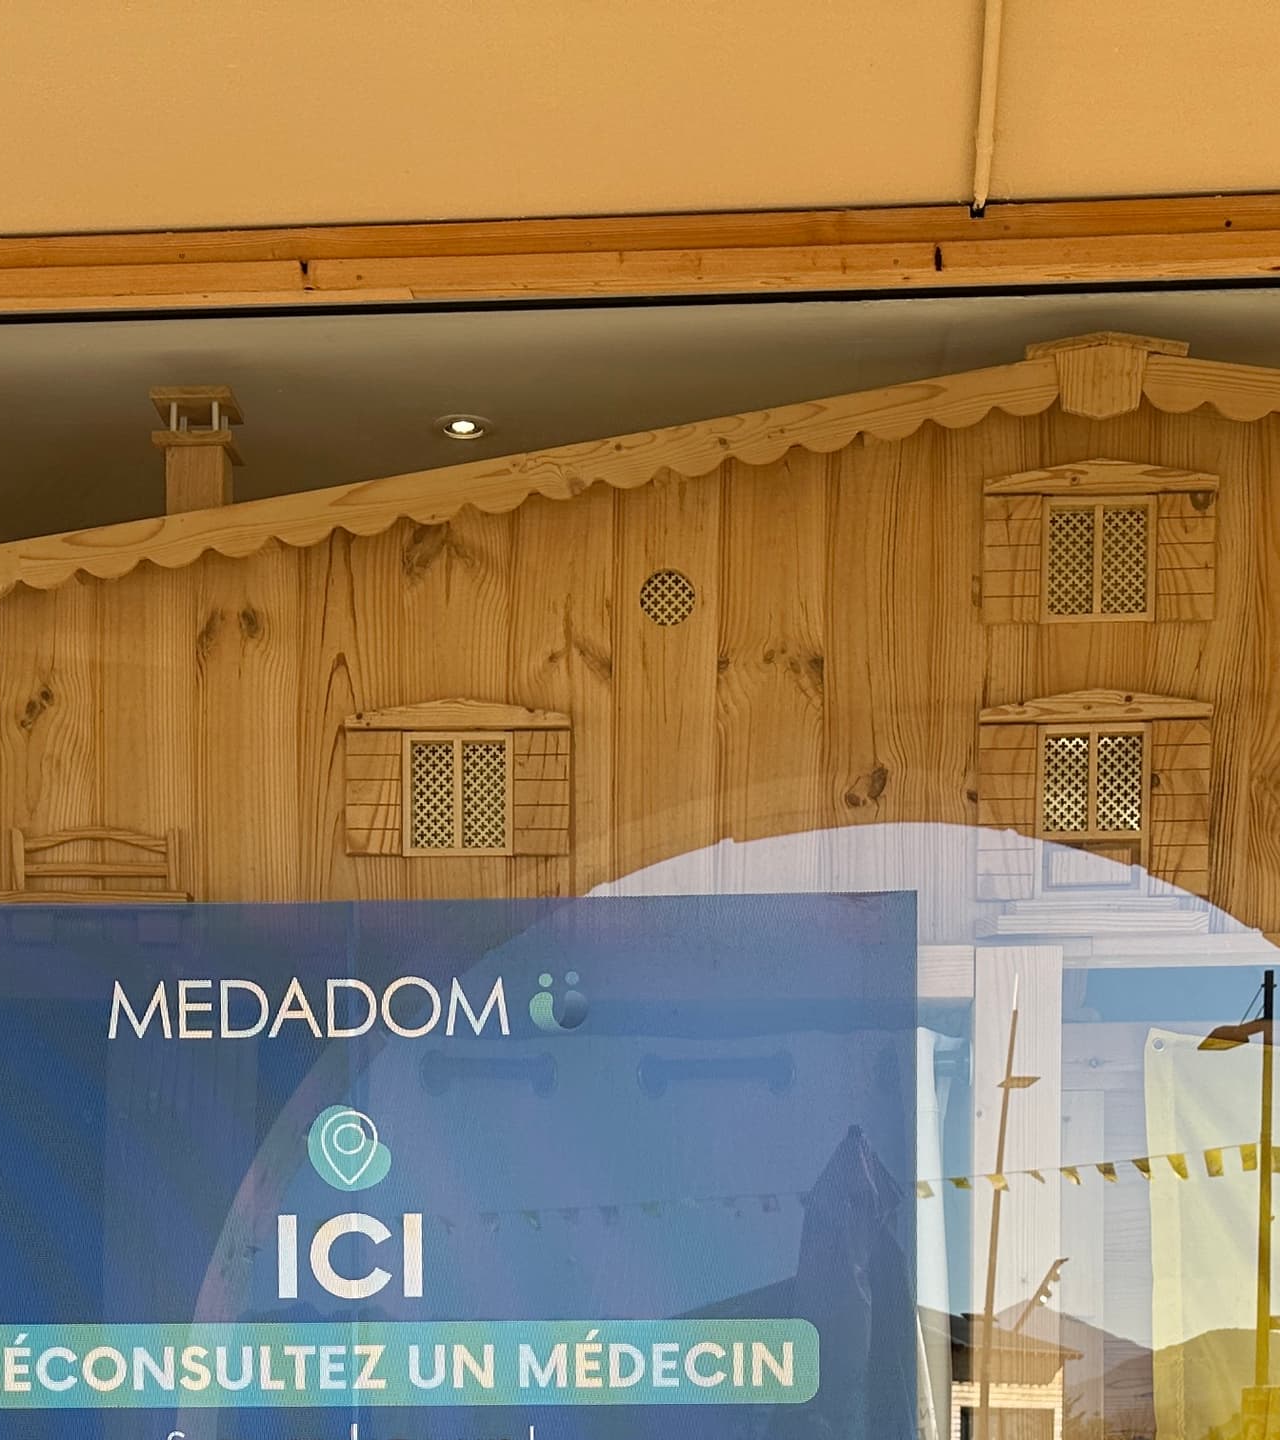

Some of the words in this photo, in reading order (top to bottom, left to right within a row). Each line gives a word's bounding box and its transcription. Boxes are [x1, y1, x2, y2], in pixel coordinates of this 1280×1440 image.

[108, 976, 511, 1040] MEDADOM
[277, 1212, 423, 1300] ICI
[408, 1343, 496, 1389] UN
[519, 1330, 795, 1389] MÉDECIN
